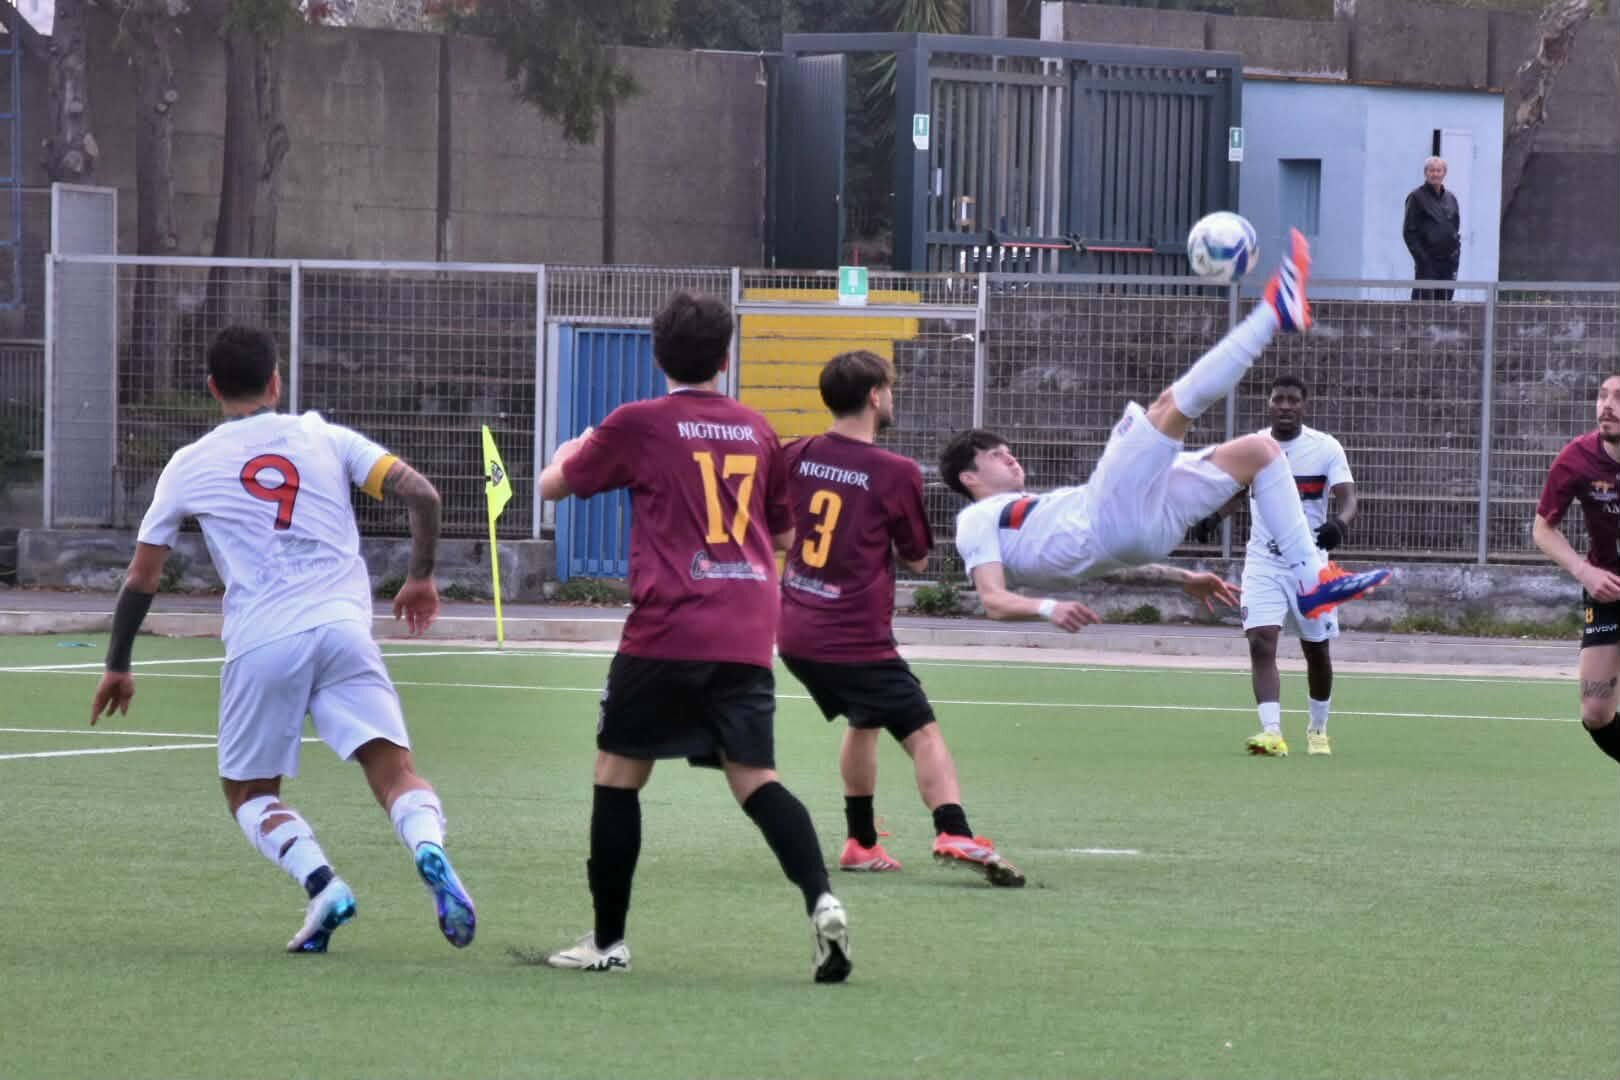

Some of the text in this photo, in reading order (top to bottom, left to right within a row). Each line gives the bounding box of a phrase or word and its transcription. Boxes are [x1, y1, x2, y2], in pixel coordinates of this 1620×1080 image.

[678, 422, 758, 444] NIGITHOR
[240, 454, 299, 530] 9
[692, 452, 757, 546] 17
[799, 461, 869, 490] NIGITHOR
[801, 490, 842, 569] 3
